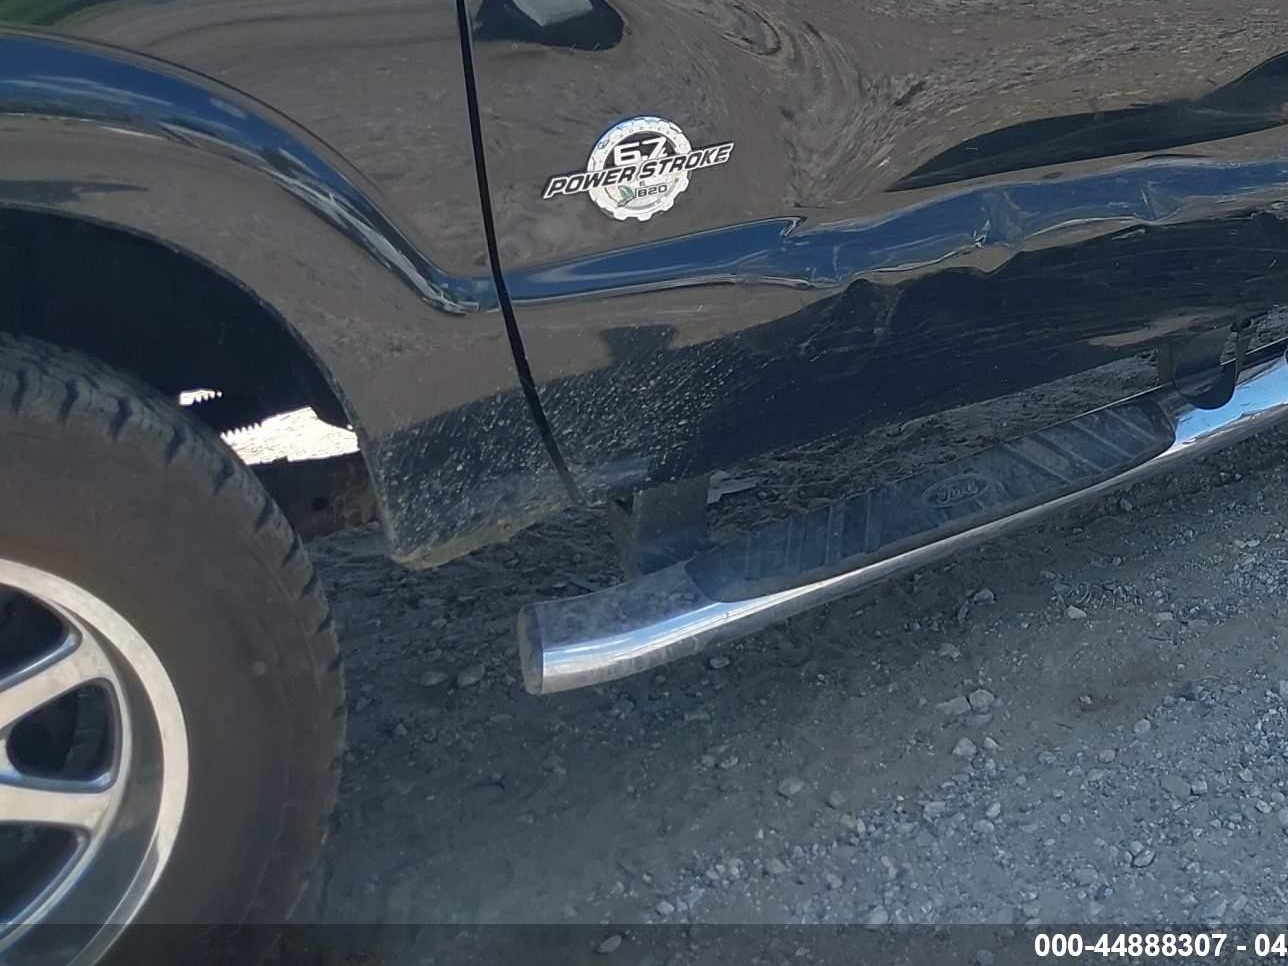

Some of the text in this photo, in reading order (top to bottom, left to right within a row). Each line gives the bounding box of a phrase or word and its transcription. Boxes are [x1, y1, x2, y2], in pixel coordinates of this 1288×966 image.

[544, 143, 734, 198] POWER STROKE
[637, 184, 668, 199] B20
